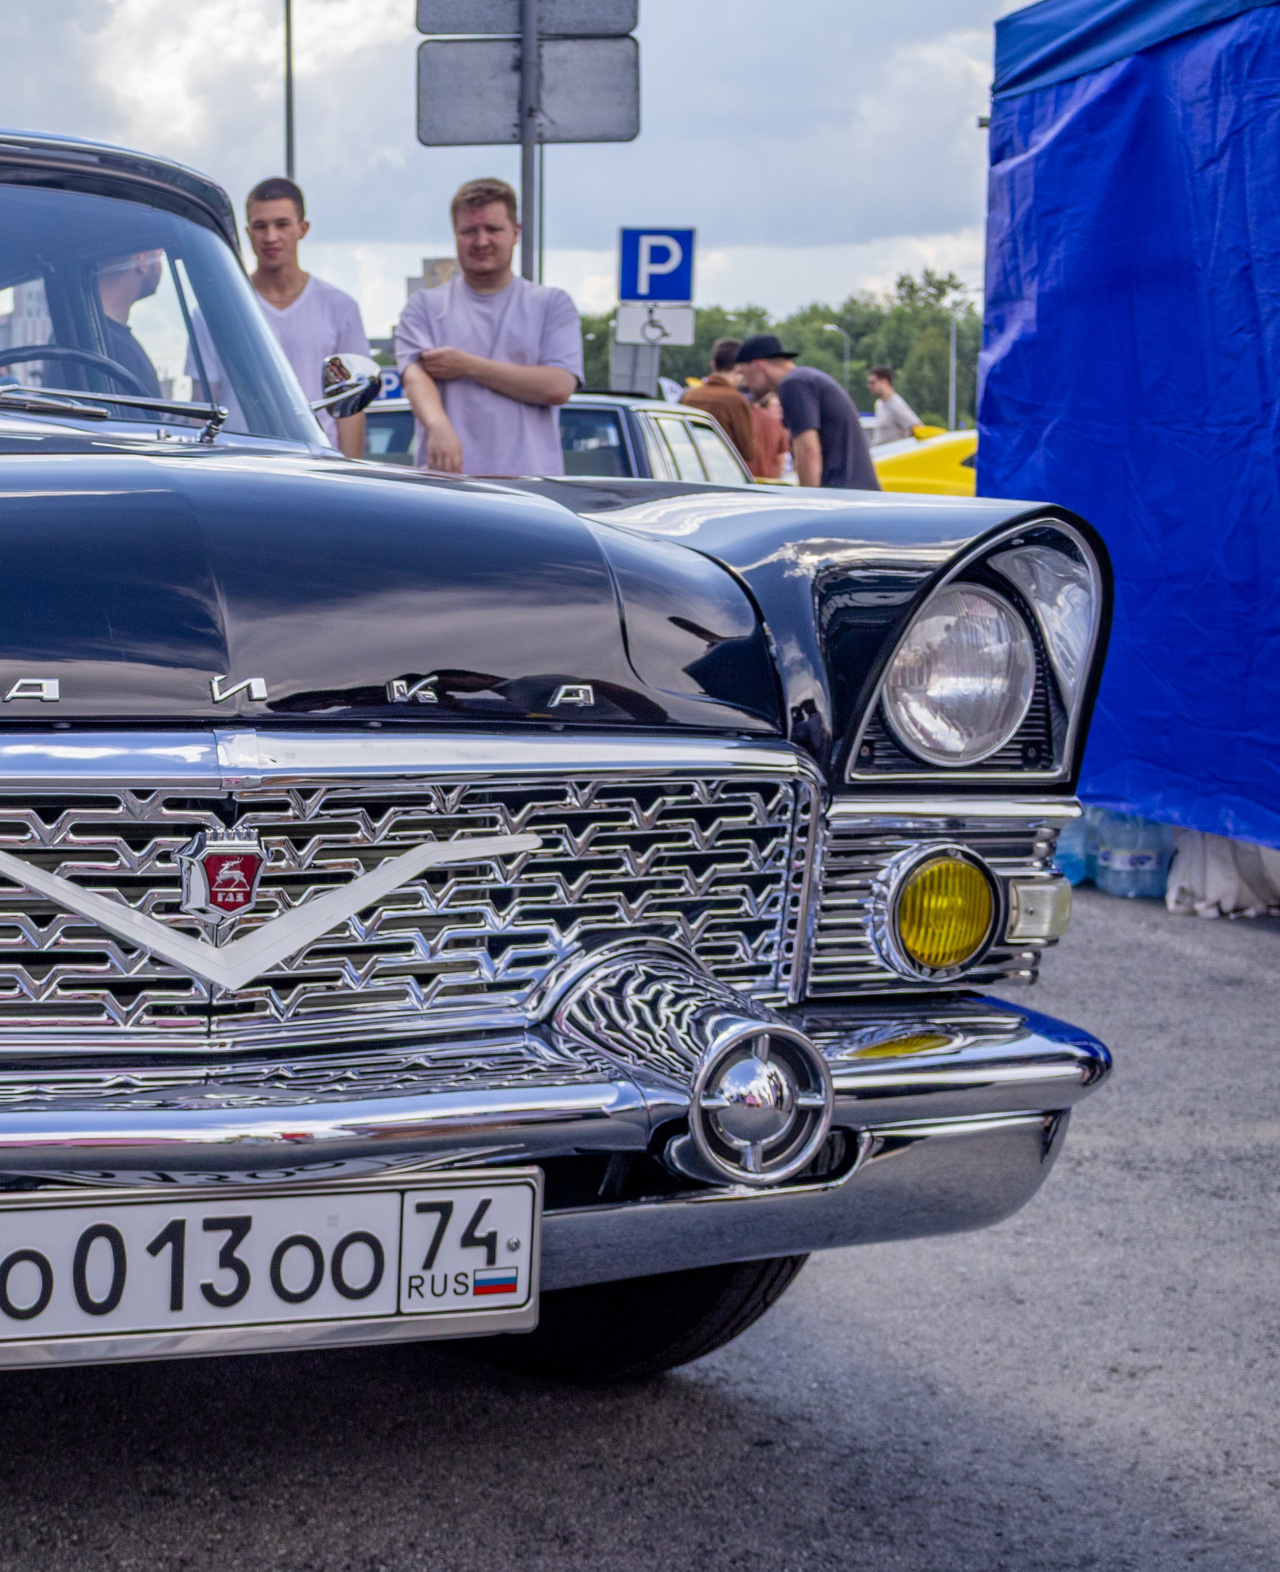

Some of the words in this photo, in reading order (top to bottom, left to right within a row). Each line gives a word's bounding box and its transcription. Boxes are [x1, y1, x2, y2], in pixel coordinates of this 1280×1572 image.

[637, 235, 683, 296] P
[380, 371, 400, 399] P
[217, 892, 245, 902] ГАЗ
[415, 1198, 498, 1270] 74
[408, 1272, 469, 1299] RUS
